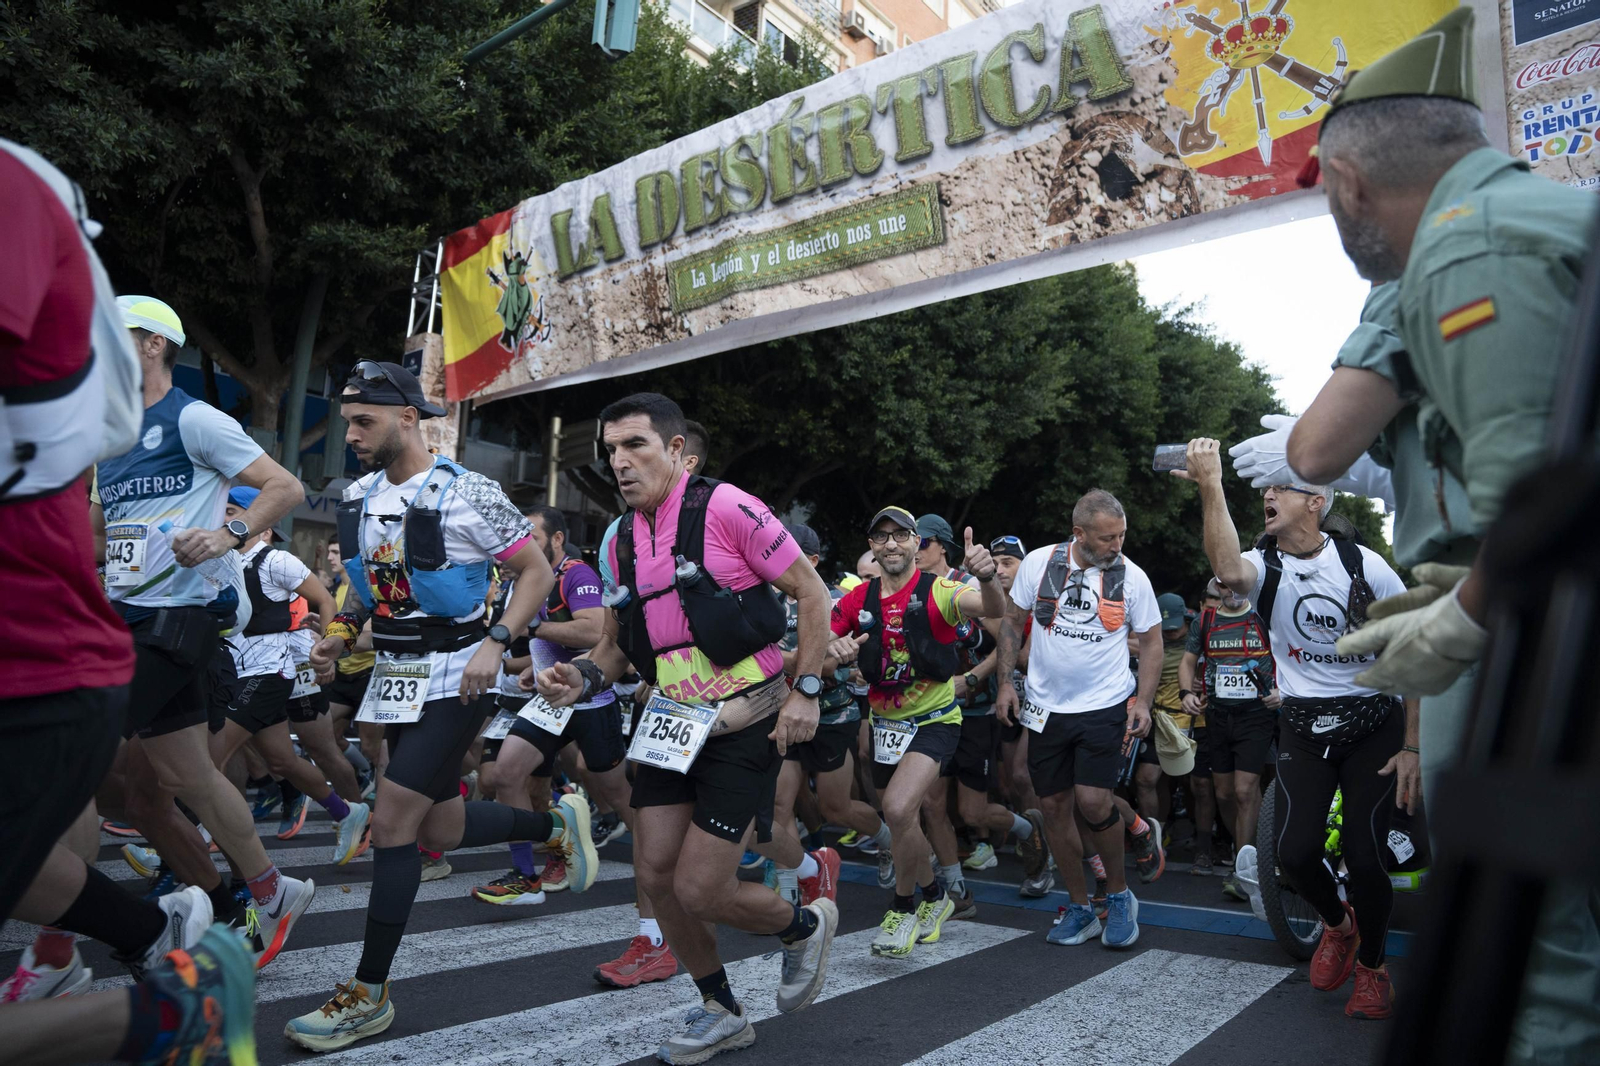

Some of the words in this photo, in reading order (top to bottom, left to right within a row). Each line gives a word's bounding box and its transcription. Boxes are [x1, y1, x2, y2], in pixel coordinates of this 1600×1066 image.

[551, 192, 625, 282] LA
[635, 2, 1134, 250] DESÉRTICA
[691, 268, 706, 289] La
[711, 254, 743, 282] Legión
[751, 251, 760, 274] y
[768, 244, 780, 266] el
[787, 231, 840, 262] desierto
[846, 222, 871, 245] nos
[878, 214, 907, 236] une
[762, 549, 771, 560] LA
[770, 530, 787, 552] MAREA
[577, 586, 599, 595] RT22
[1064, 597, 1091, 610] AND
[1305, 611, 1337, 628] AND
[1209, 640, 1217, 648] LA
[1224, 676, 1252, 687] 2912
[1317, 715, 1340, 726] NIKE
[649, 716, 693, 746] 2546
